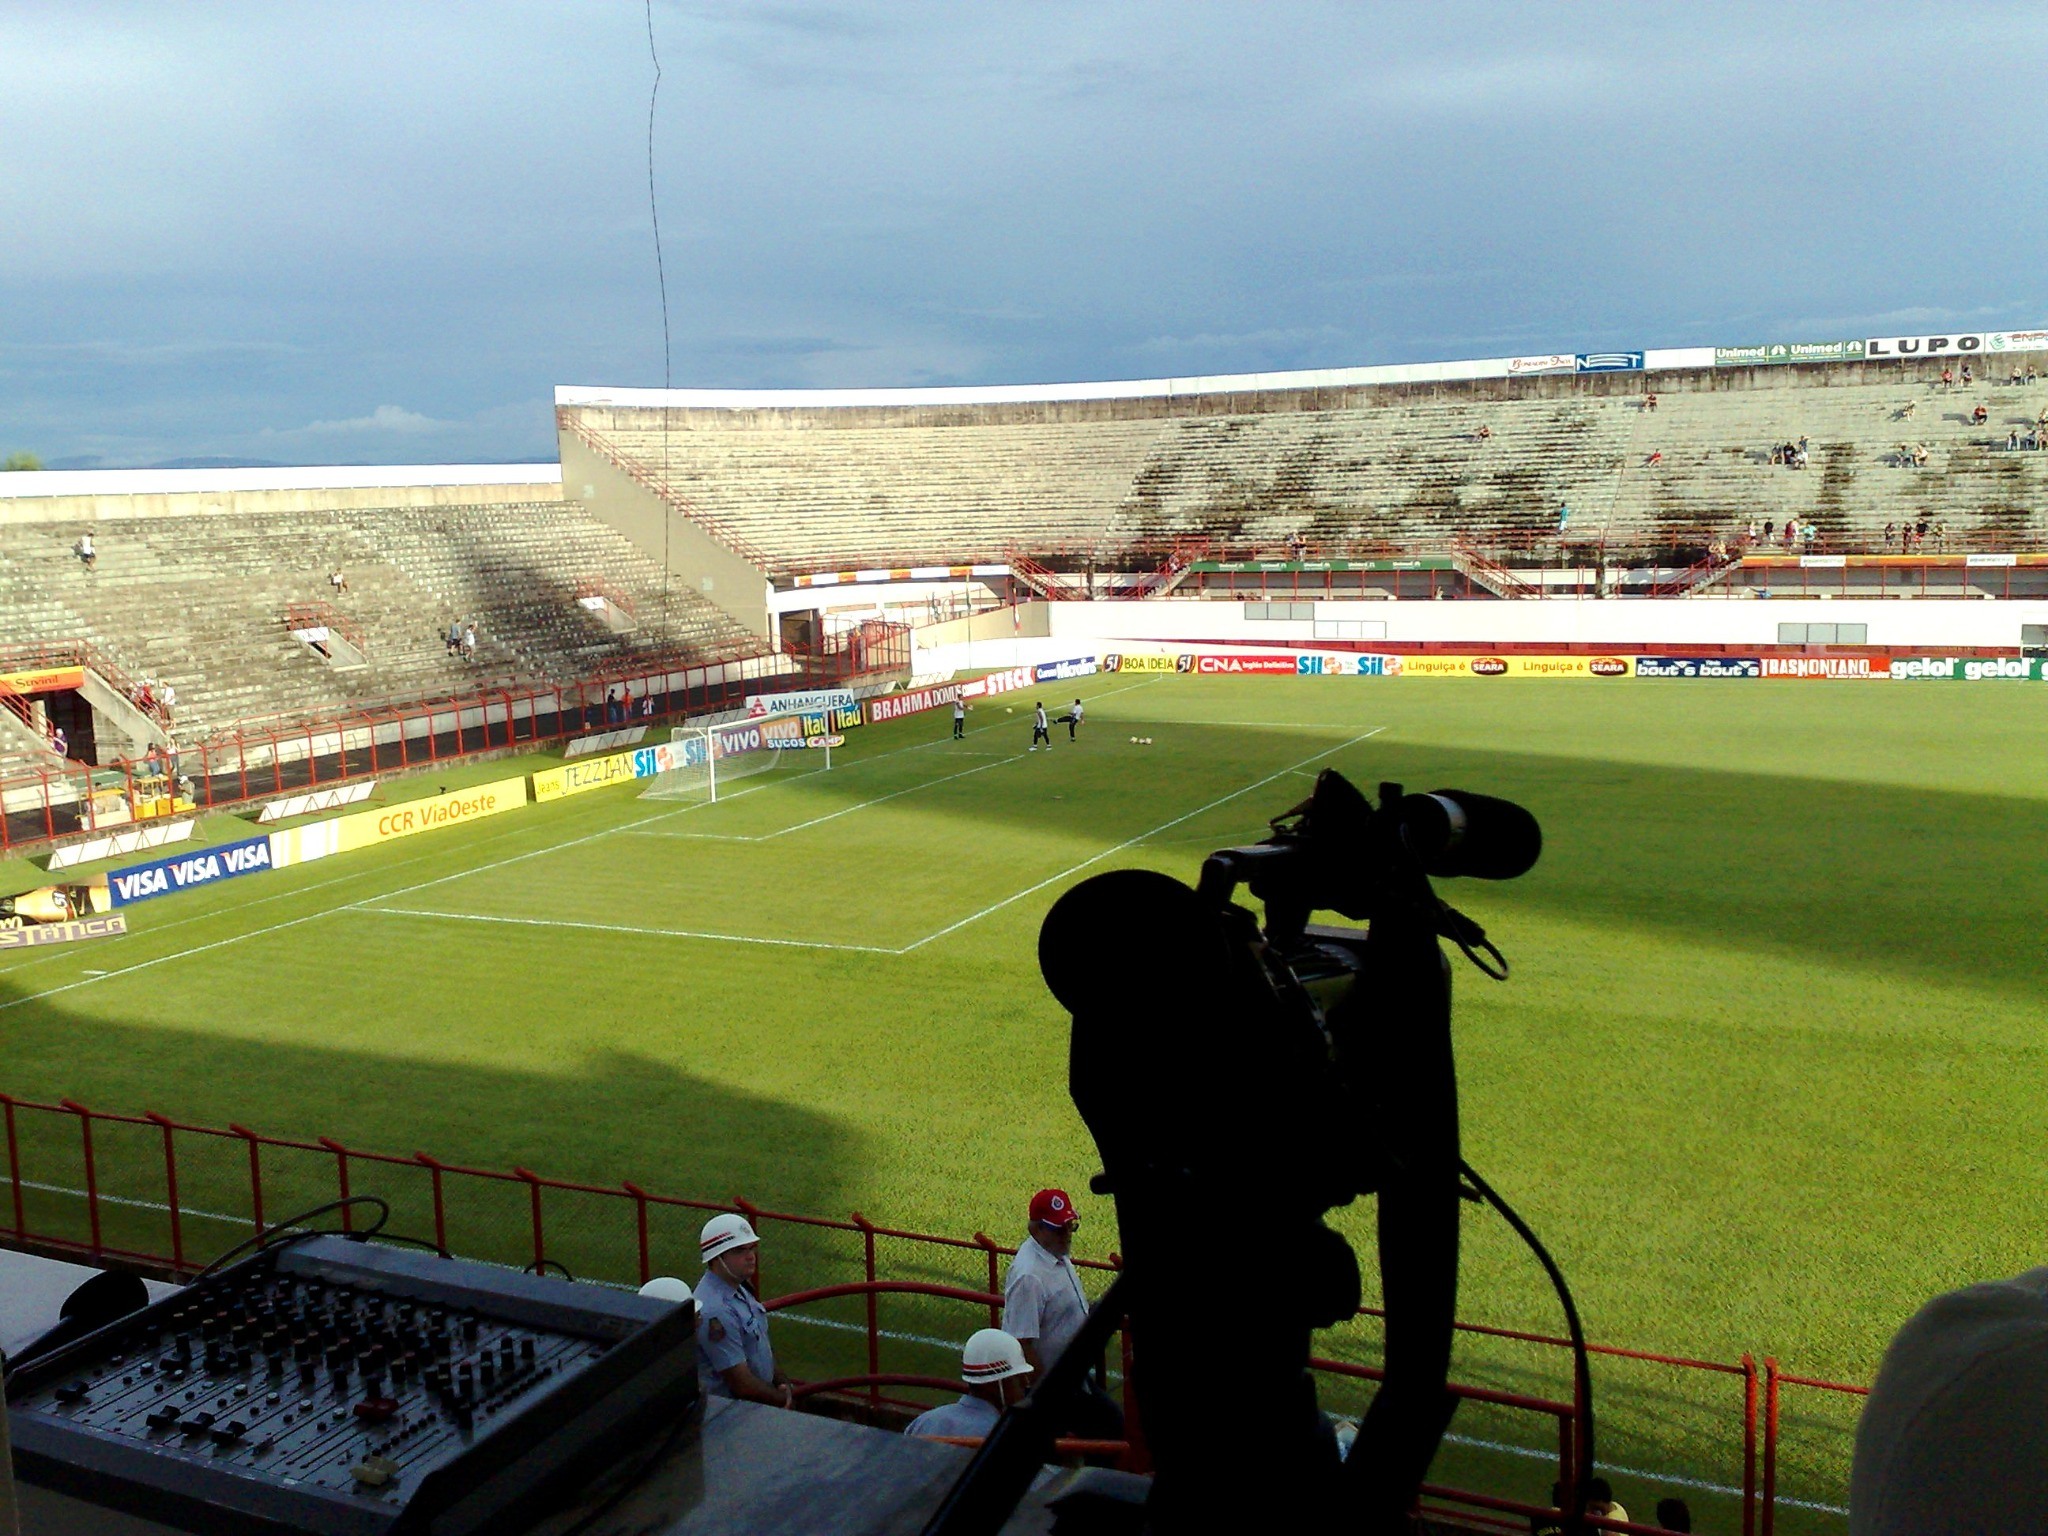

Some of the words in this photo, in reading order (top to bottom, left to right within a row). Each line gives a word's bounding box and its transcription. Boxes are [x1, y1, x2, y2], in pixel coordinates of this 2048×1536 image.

[1717, 346, 1765, 357] Unimed
[1791, 342, 1842, 354] Unimed
[1869, 337, 1980, 355] LUPO
[1577, 353, 1641, 370] NET
[1105, 656, 1118, 672] 51
[1124, 657, 1145, 669] BOA
[1148, 657, 1174, 669] IDEIA
[1178, 656, 1191, 672] 51
[1200, 658, 1243, 672] CNA
[1298, 656, 1323, 674] Sil
[1358, 656, 1383, 674] Sil
[1408, 661, 1456, 672] Linguiça
[1459, 661, 1466, 671] é
[1472, 663, 1505, 672] SEARA
[1523, 661, 1573, 672] Linguiça
[1577, 661, 1584, 671] é
[1591, 664, 1625, 672] SEARA
[1761, 659, 1870, 676] TRASMONTANO
[1890, 657, 1954, 680] gelol
[1964, 657, 2030, 680] gelol
[15, 675, 59, 688] Suvinil
[987, 667, 1034, 696] STECK
[770, 694, 852, 712] ANHANGUERA
[873, 691, 931, 722] BRAHMA
[837, 704, 861, 729] Itaú
[723, 730, 759, 753] VIVO
[767, 738, 806, 749] SUCOS
[635, 749, 657, 778] Sil
[379, 811, 414, 835] CCR
[421, 795, 496, 825] ViaOeste
[220, 842, 269, 873] VISA
[169, 855, 220, 886] VISA
[114, 869, 168, 900] VISA
